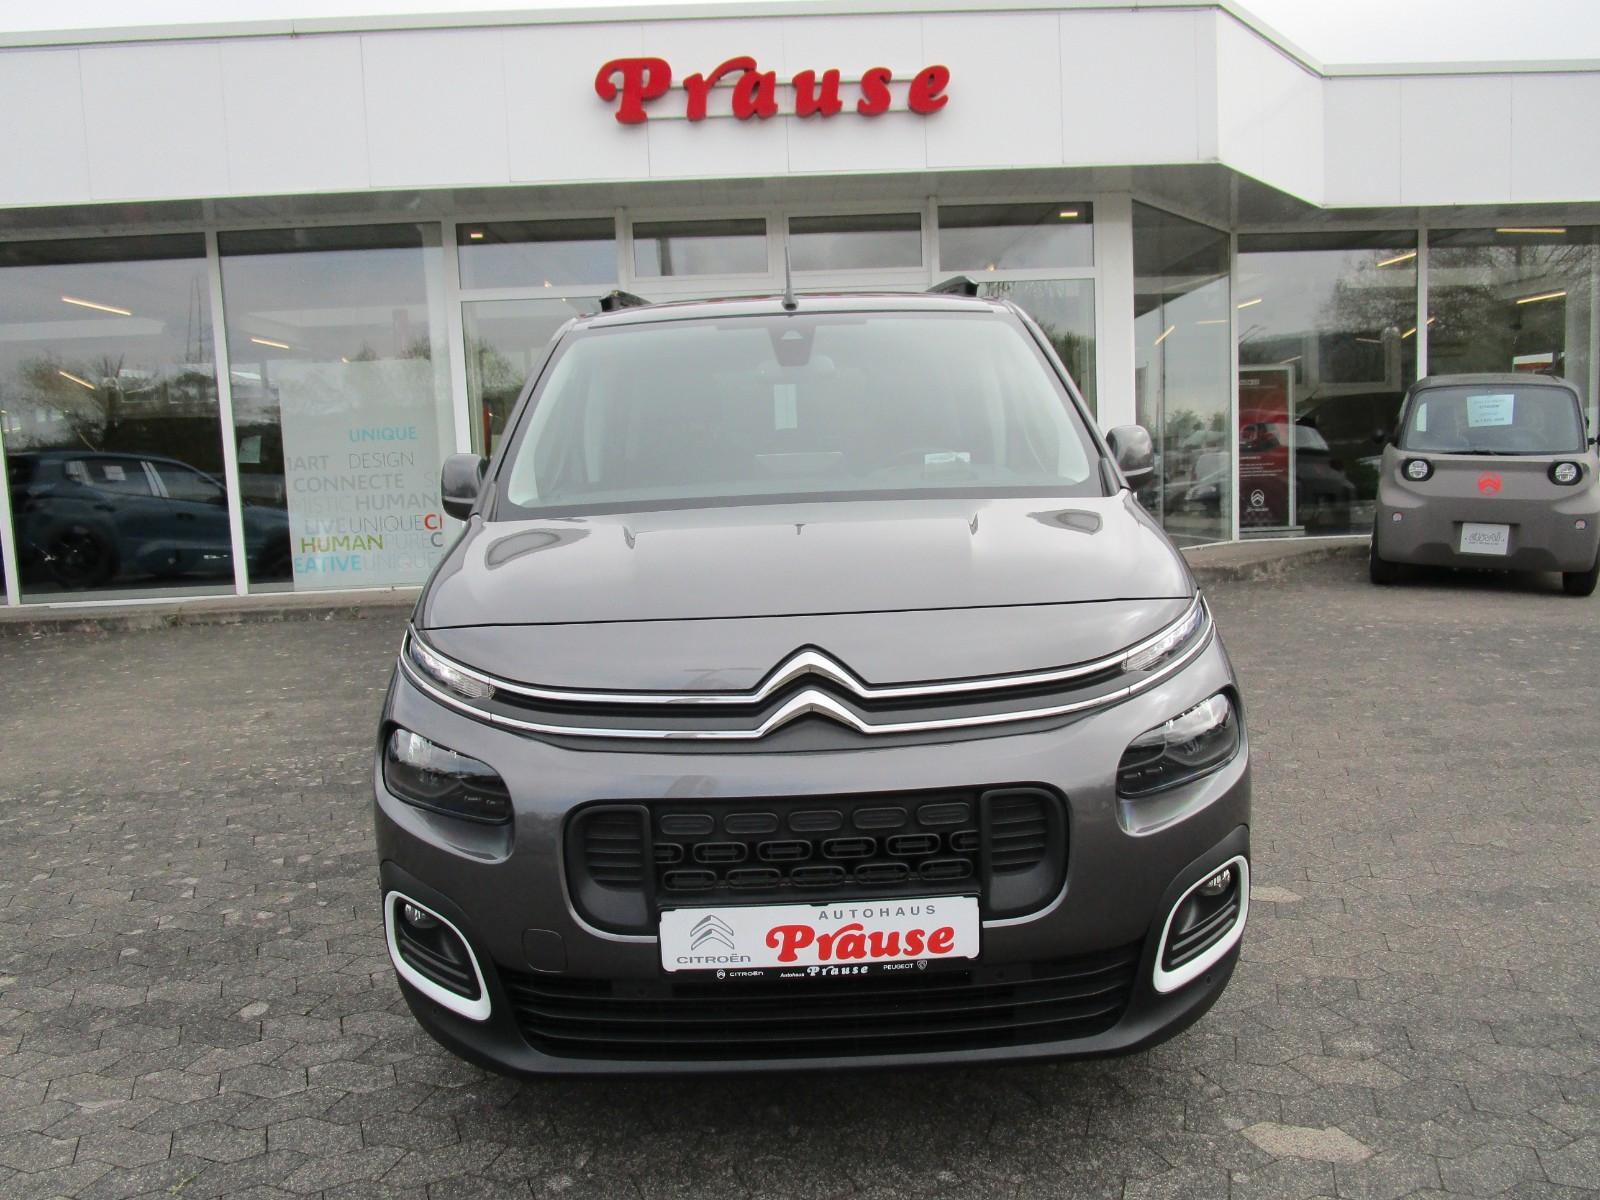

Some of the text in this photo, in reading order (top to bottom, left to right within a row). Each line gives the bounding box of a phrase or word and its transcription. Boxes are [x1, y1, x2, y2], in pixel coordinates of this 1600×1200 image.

[595, 56, 950, 124] Prause
[349, 426, 417, 443] UNIQUE
[349, 451, 415, 469] DESIGN
[355, 492, 438, 511] HUMAN
[350, 514, 424, 534] UNIQUE
[301, 533, 384, 553] HUMAN
[818, 905, 936, 920] AUTOHAUS
[766, 923, 955, 962] Prause
[807, 966, 869, 977] Prause
